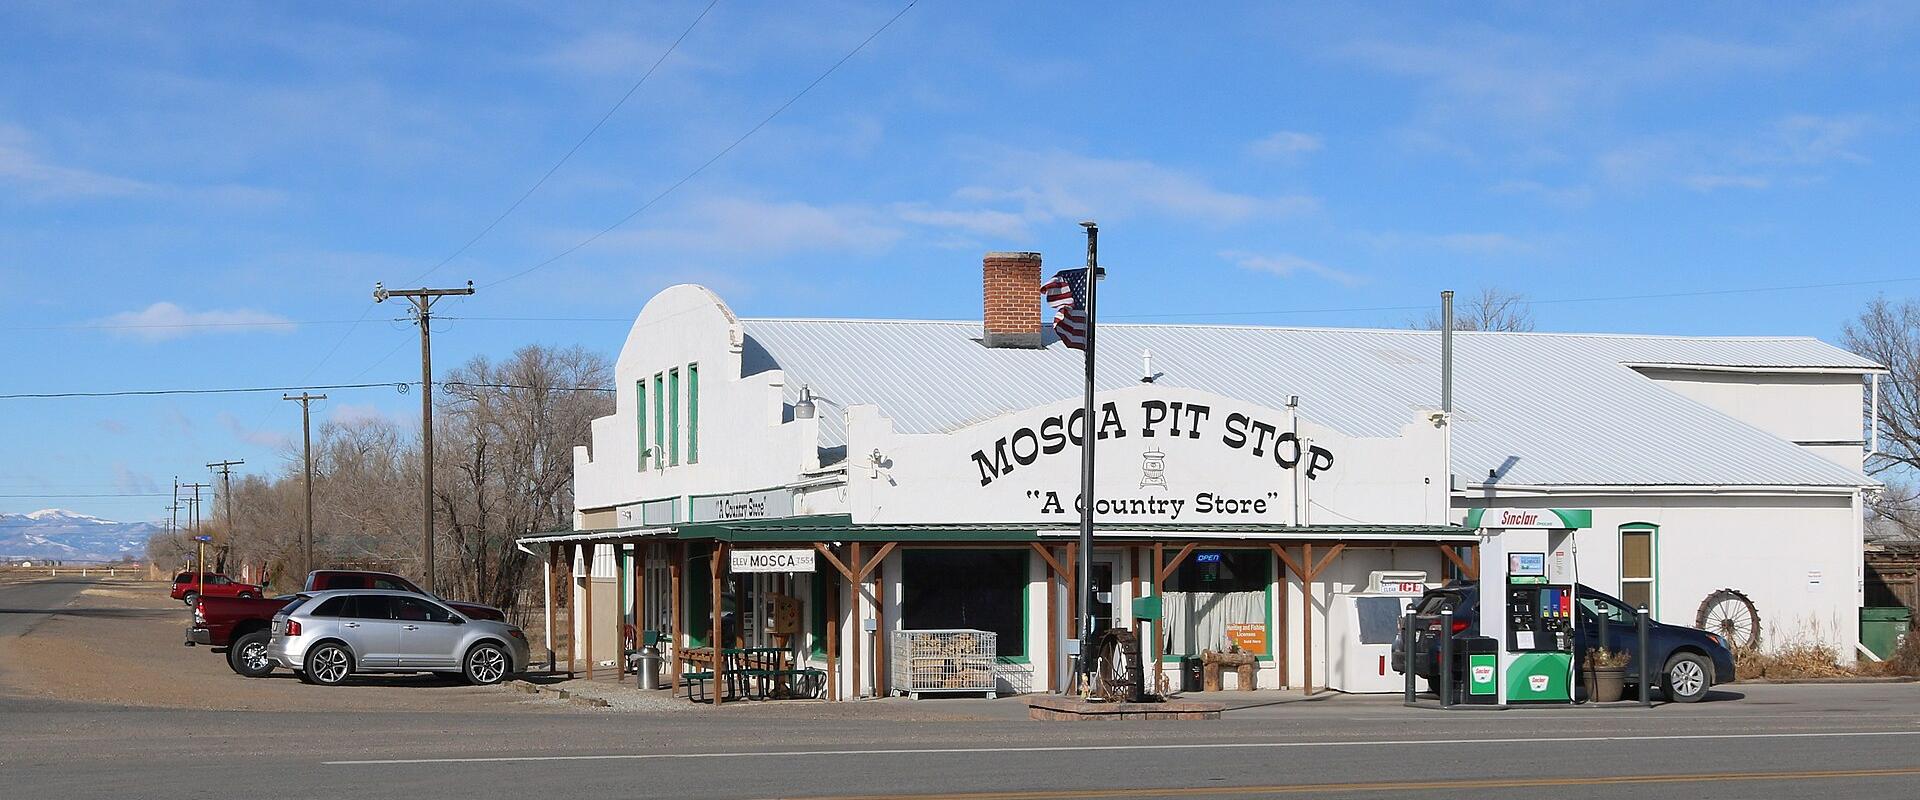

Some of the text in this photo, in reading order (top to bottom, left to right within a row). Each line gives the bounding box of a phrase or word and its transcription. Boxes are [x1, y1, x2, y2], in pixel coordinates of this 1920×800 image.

[1141, 400, 1210, 439] PIT
[1222, 412, 1334, 481] STOP
[1501, 511, 1538, 525] Sinclair
[733, 557, 748, 566] ELEV
[750, 555, 795, 567] MOSCA
